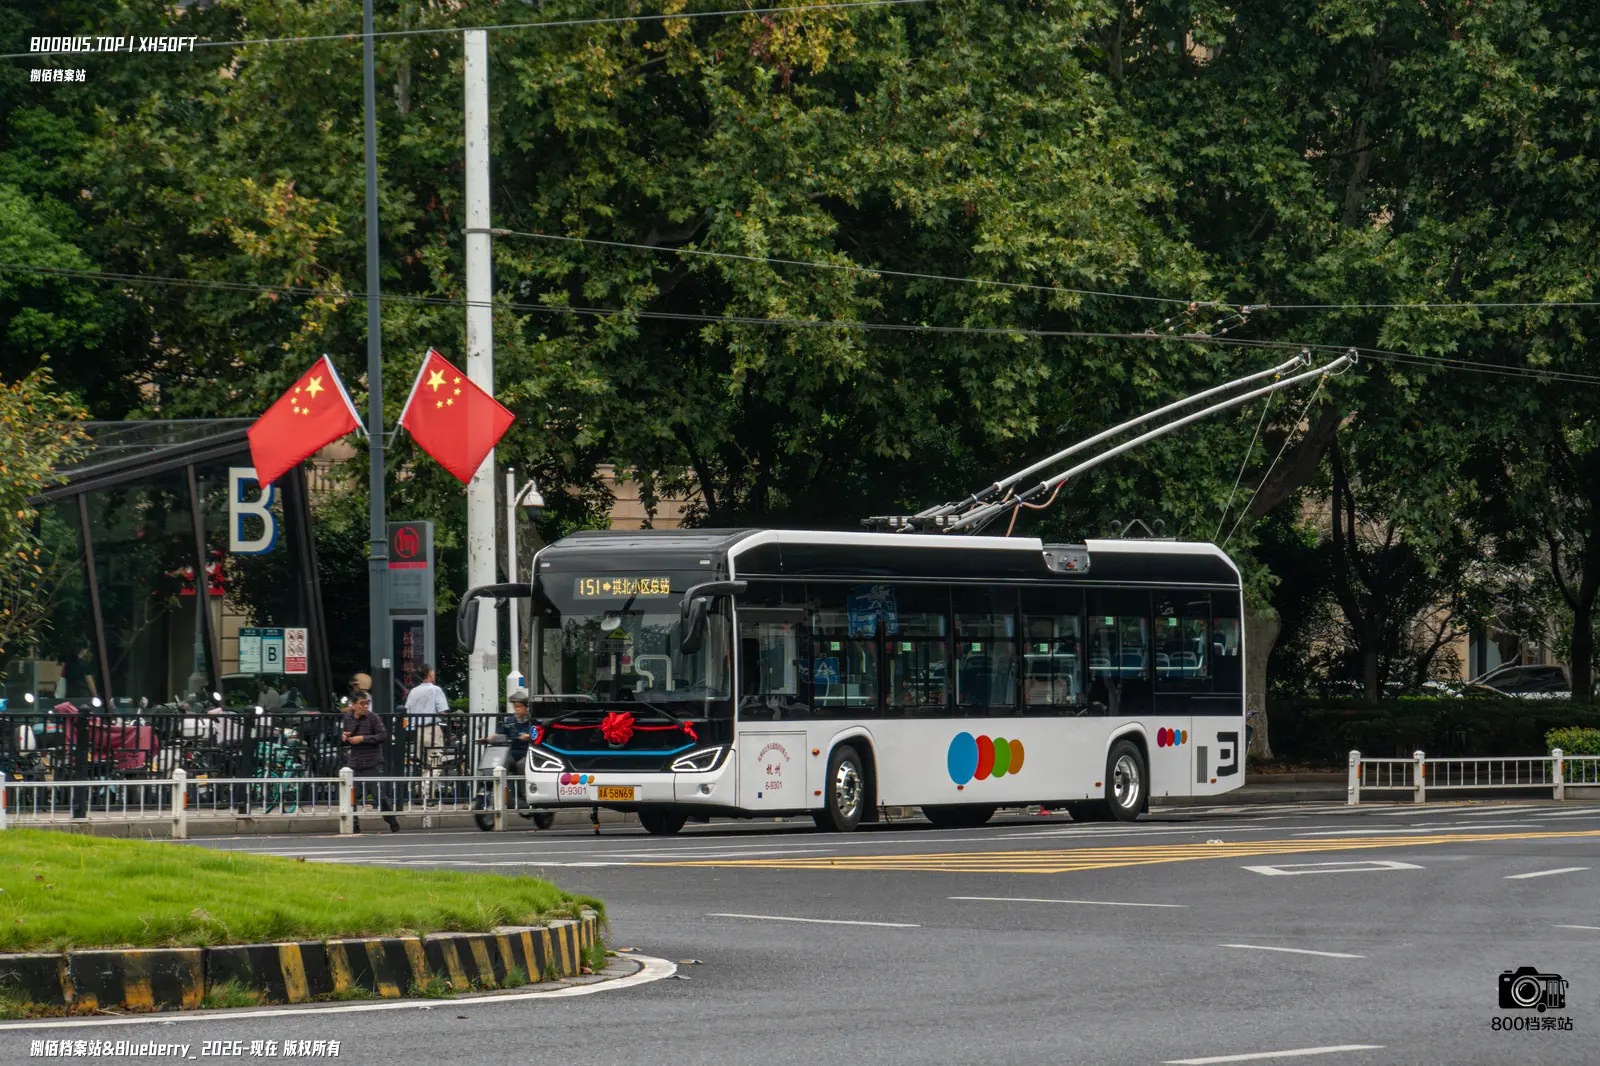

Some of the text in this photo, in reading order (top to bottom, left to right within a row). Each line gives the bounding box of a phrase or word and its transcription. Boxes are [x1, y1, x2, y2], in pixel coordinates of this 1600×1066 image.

[228, 467, 278, 554] B
[580, 579, 600, 595] 151
[268, 647, 277, 661] B
[560, 787, 587, 795] 6-9301
